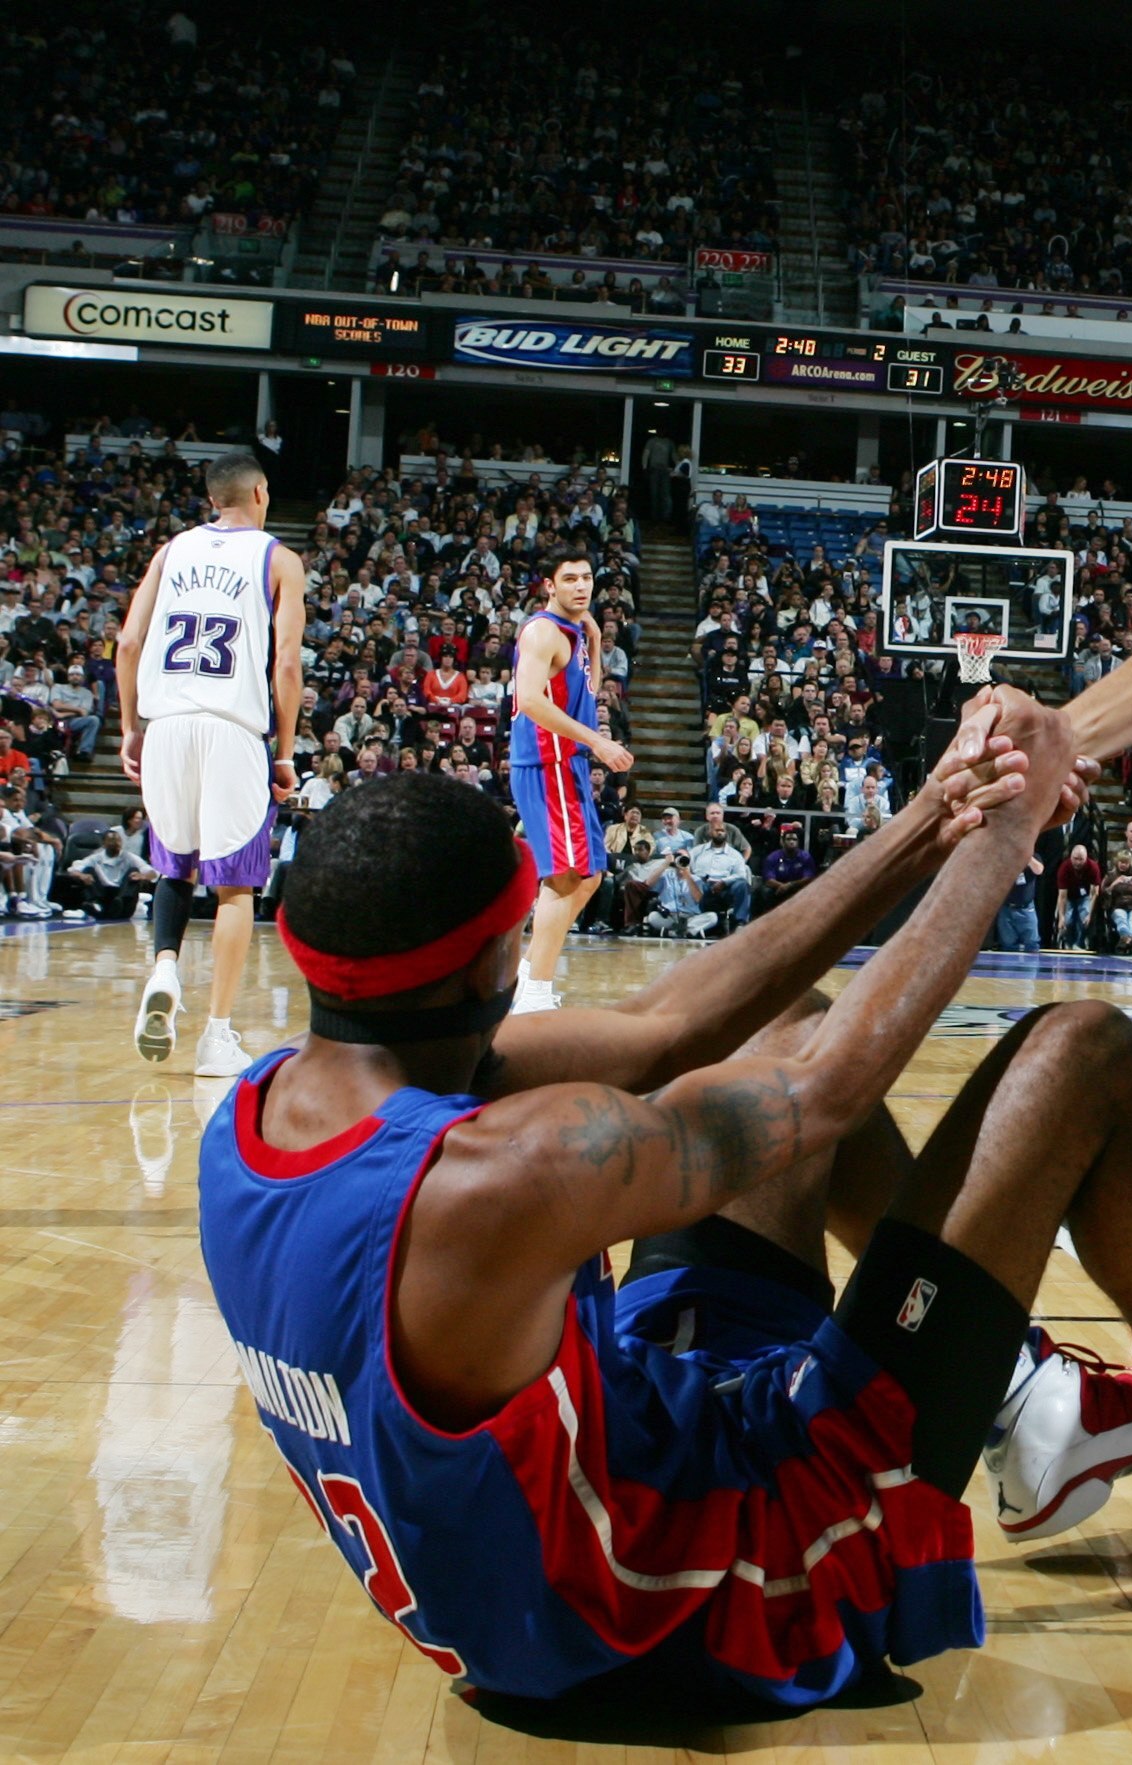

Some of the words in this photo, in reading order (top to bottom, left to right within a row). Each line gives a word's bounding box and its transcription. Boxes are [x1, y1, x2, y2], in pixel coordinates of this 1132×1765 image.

[77, 302, 230, 333] comcast
[305, 313, 330, 327] NBA
[334, 315, 419, 332] OUT-OF-TOWN
[334, 329, 382, 343] SCORES
[460, 326, 557, 351] BUD
[560, 334, 690, 360] LIGHT
[715, 337, 750, 348] HOME
[873, 344, 886, 361] 2
[897, 350, 936, 362] GUEST
[386, 364, 420, 377] 120
[722, 356, 746, 374] 33
[791, 364, 876, 382] ARCOArena.com
[905, 370, 930, 387] 31
[1040, 409, 1061, 422] 121
[954, 493, 1004, 526] 24
[169, 565, 250, 600] MARTIN
[162, 611, 241, 678] 23
